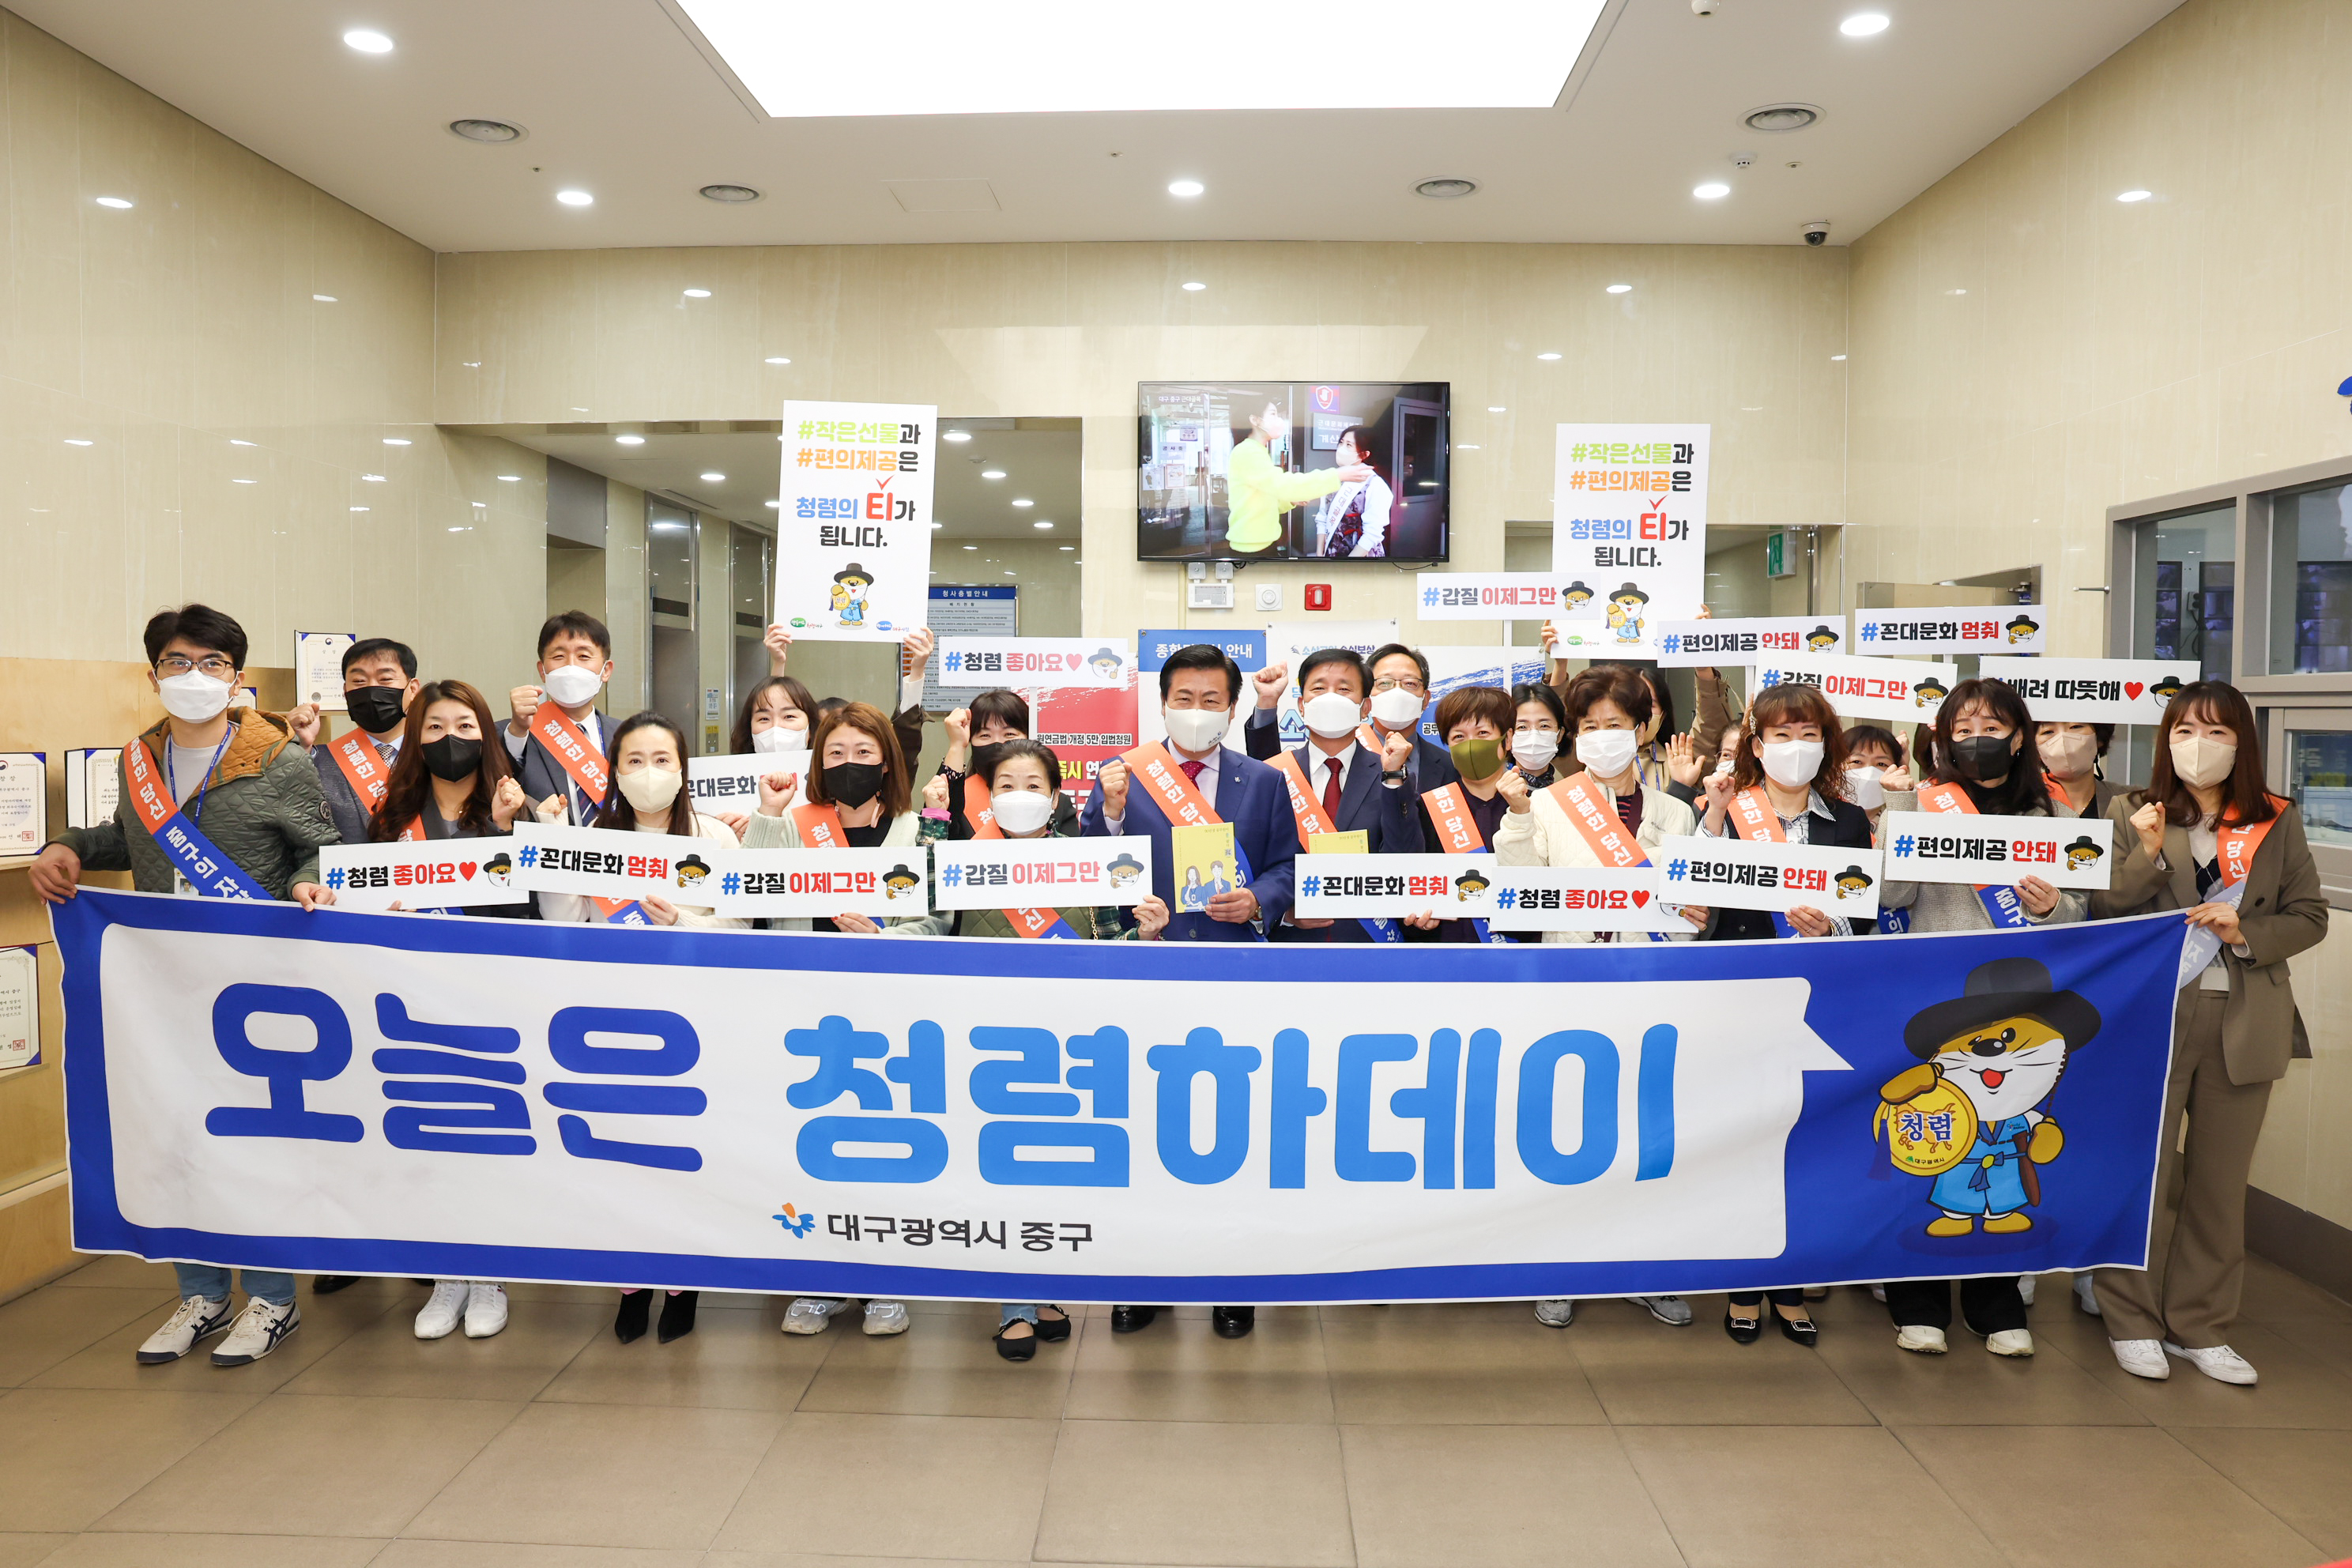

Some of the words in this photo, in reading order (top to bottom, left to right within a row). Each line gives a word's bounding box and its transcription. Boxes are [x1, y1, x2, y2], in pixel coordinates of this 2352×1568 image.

[797, 420, 921, 445] #작은선물과
[796, 448, 918, 473] #편의제공은
[1570, 443, 1694, 465] #작은선물과
[1570, 470, 1692, 492] #편의제공은
[796, 496, 858, 519] 청렴의
[865, 492, 916, 522] 티가
[820, 525, 888, 548] 됩니다.
[1570, 518, 1632, 540] 청렴의
[1639, 512, 1690, 541] 티가
[1594, 546, 1662, 567] 됩니다.
[1423, 586, 1479, 607] #갑질
[1482, 586, 1557, 605] 이제그만
[1663, 632, 1758, 654] #편의제공
[1762, 631, 1800, 650] 안돼
[1860, 621, 1959, 642] #꼰대문화
[1961, 620, 2000, 639] 멈춰
[944, 651, 1002, 672] #청렴
[1005, 653, 1064, 672] 좋아요
[1226, 643, 1253, 658] 안내
[1825, 674, 1908, 701] 이제그만
[1997, 677, 2049, 699] 배려
[2055, 680, 2121, 702] 따뜻해
[1069, 733, 1085, 745] 개정
[1086, 733, 1099, 745] 5만
[1100, 733, 1133, 745] 입법청원
[543, 719, 586, 762] 청렴한
[580, 760, 609, 792] 당신
[341, 739, 376, 779] 청렴한
[367, 779, 388, 801] 당
[1085, 760, 1103, 780] 연
[1144, 759, 1186, 805] 청렴한
[139, 782, 167, 820] 당신
[1301, 813, 1325, 835] 당
[1431, 786, 1455, 814] 렴한
[1445, 816, 1472, 850] 당신
[1566, 785, 1608, 832] 청렴한
[1600, 831, 1634, 867] 당신
[1751, 827, 1773, 842] 당
[165, 826, 219, 880] 중구의
[1894, 835, 2007, 861] #편의제공
[2011, 839, 2057, 863] 안돼
[2226, 840, 2247, 879] 당신
[518, 845, 624, 876] #꼰대문화
[628, 855, 669, 880] 멈춰
[942, 864, 1008, 888] #갑질
[1012, 861, 1101, 884] 이제그만
[1667, 858, 1779, 888] #편의제공
[1783, 867, 1828, 891] 안돼
[326, 865, 389, 890] #청렴
[394, 862, 457, 886] 좋아요
[722, 872, 786, 895] #갑질
[790, 871, 876, 894] 이제그만
[1302, 876, 1406, 897] #꼰대문화
[1408, 875, 1448, 896] 멈춰
[1497, 888, 1561, 910] #청렴
[1565, 888, 1628, 910] 좋아요
[1994, 888, 2037, 928] 중구
[1017, 908, 1046, 932] 신
[205, 981, 708, 1173] 오늘은
[783, 1014, 1679, 1189] 청렴하데이
[1898, 1112, 1952, 1143] 청렴
[1914, 1157, 1945, 1166] 대구광역시
[827, 1211, 1008, 1252] 대구광역시
[1020, 1219, 1095, 1254] 중구
